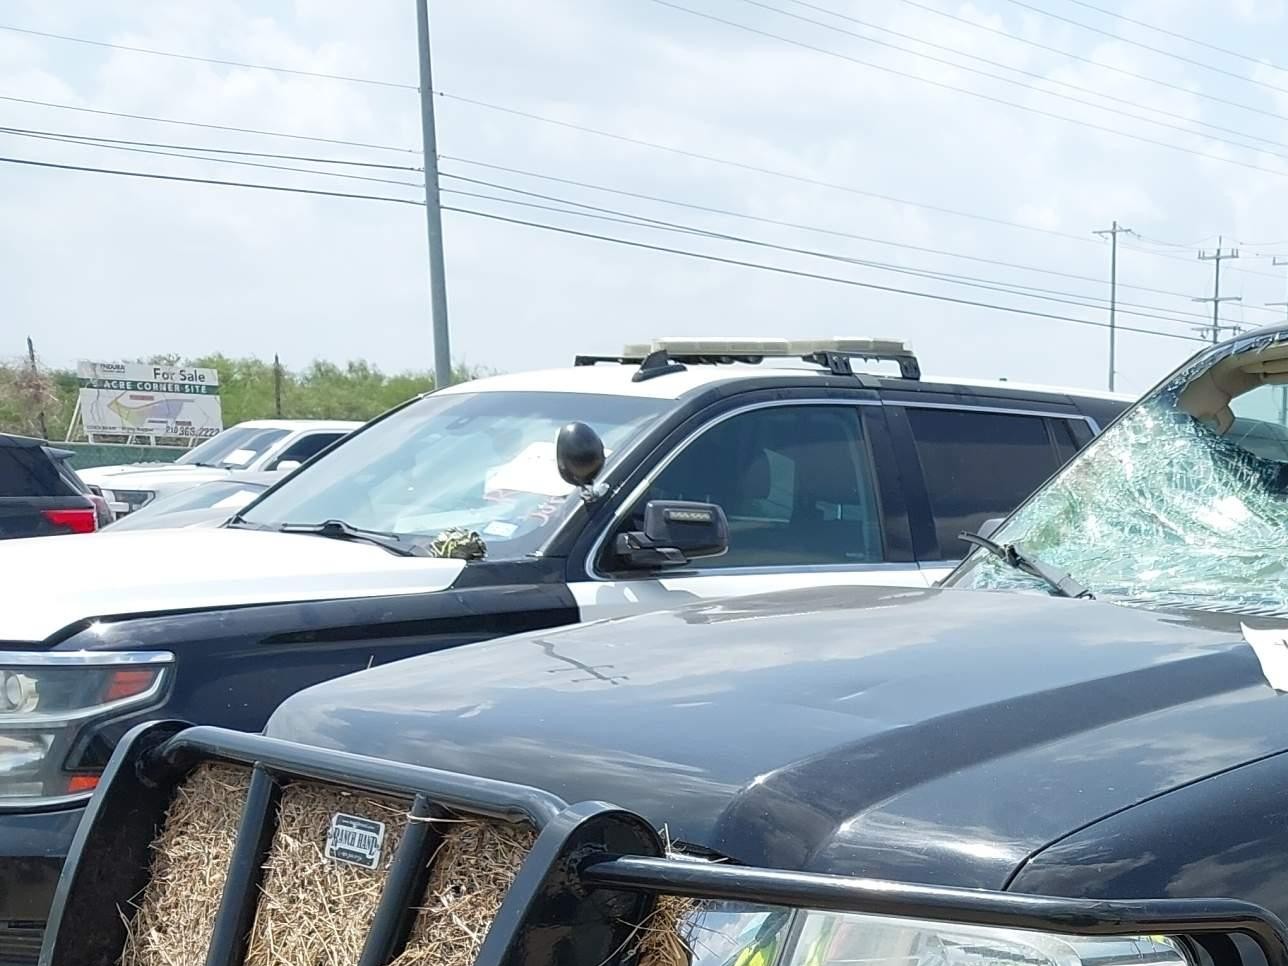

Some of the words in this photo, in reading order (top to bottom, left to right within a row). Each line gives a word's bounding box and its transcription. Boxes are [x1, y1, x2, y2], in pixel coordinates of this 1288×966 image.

[153, 367, 175, 381] For
[179, 369, 206, 383] Sale
[103, 380, 134, 390] ACRE
[136, 382, 181, 393] CORNER
[184, 384, 208, 394] SITE
[331, 827, 357, 847] RANCH
[357, 832, 379, 856] HAND
